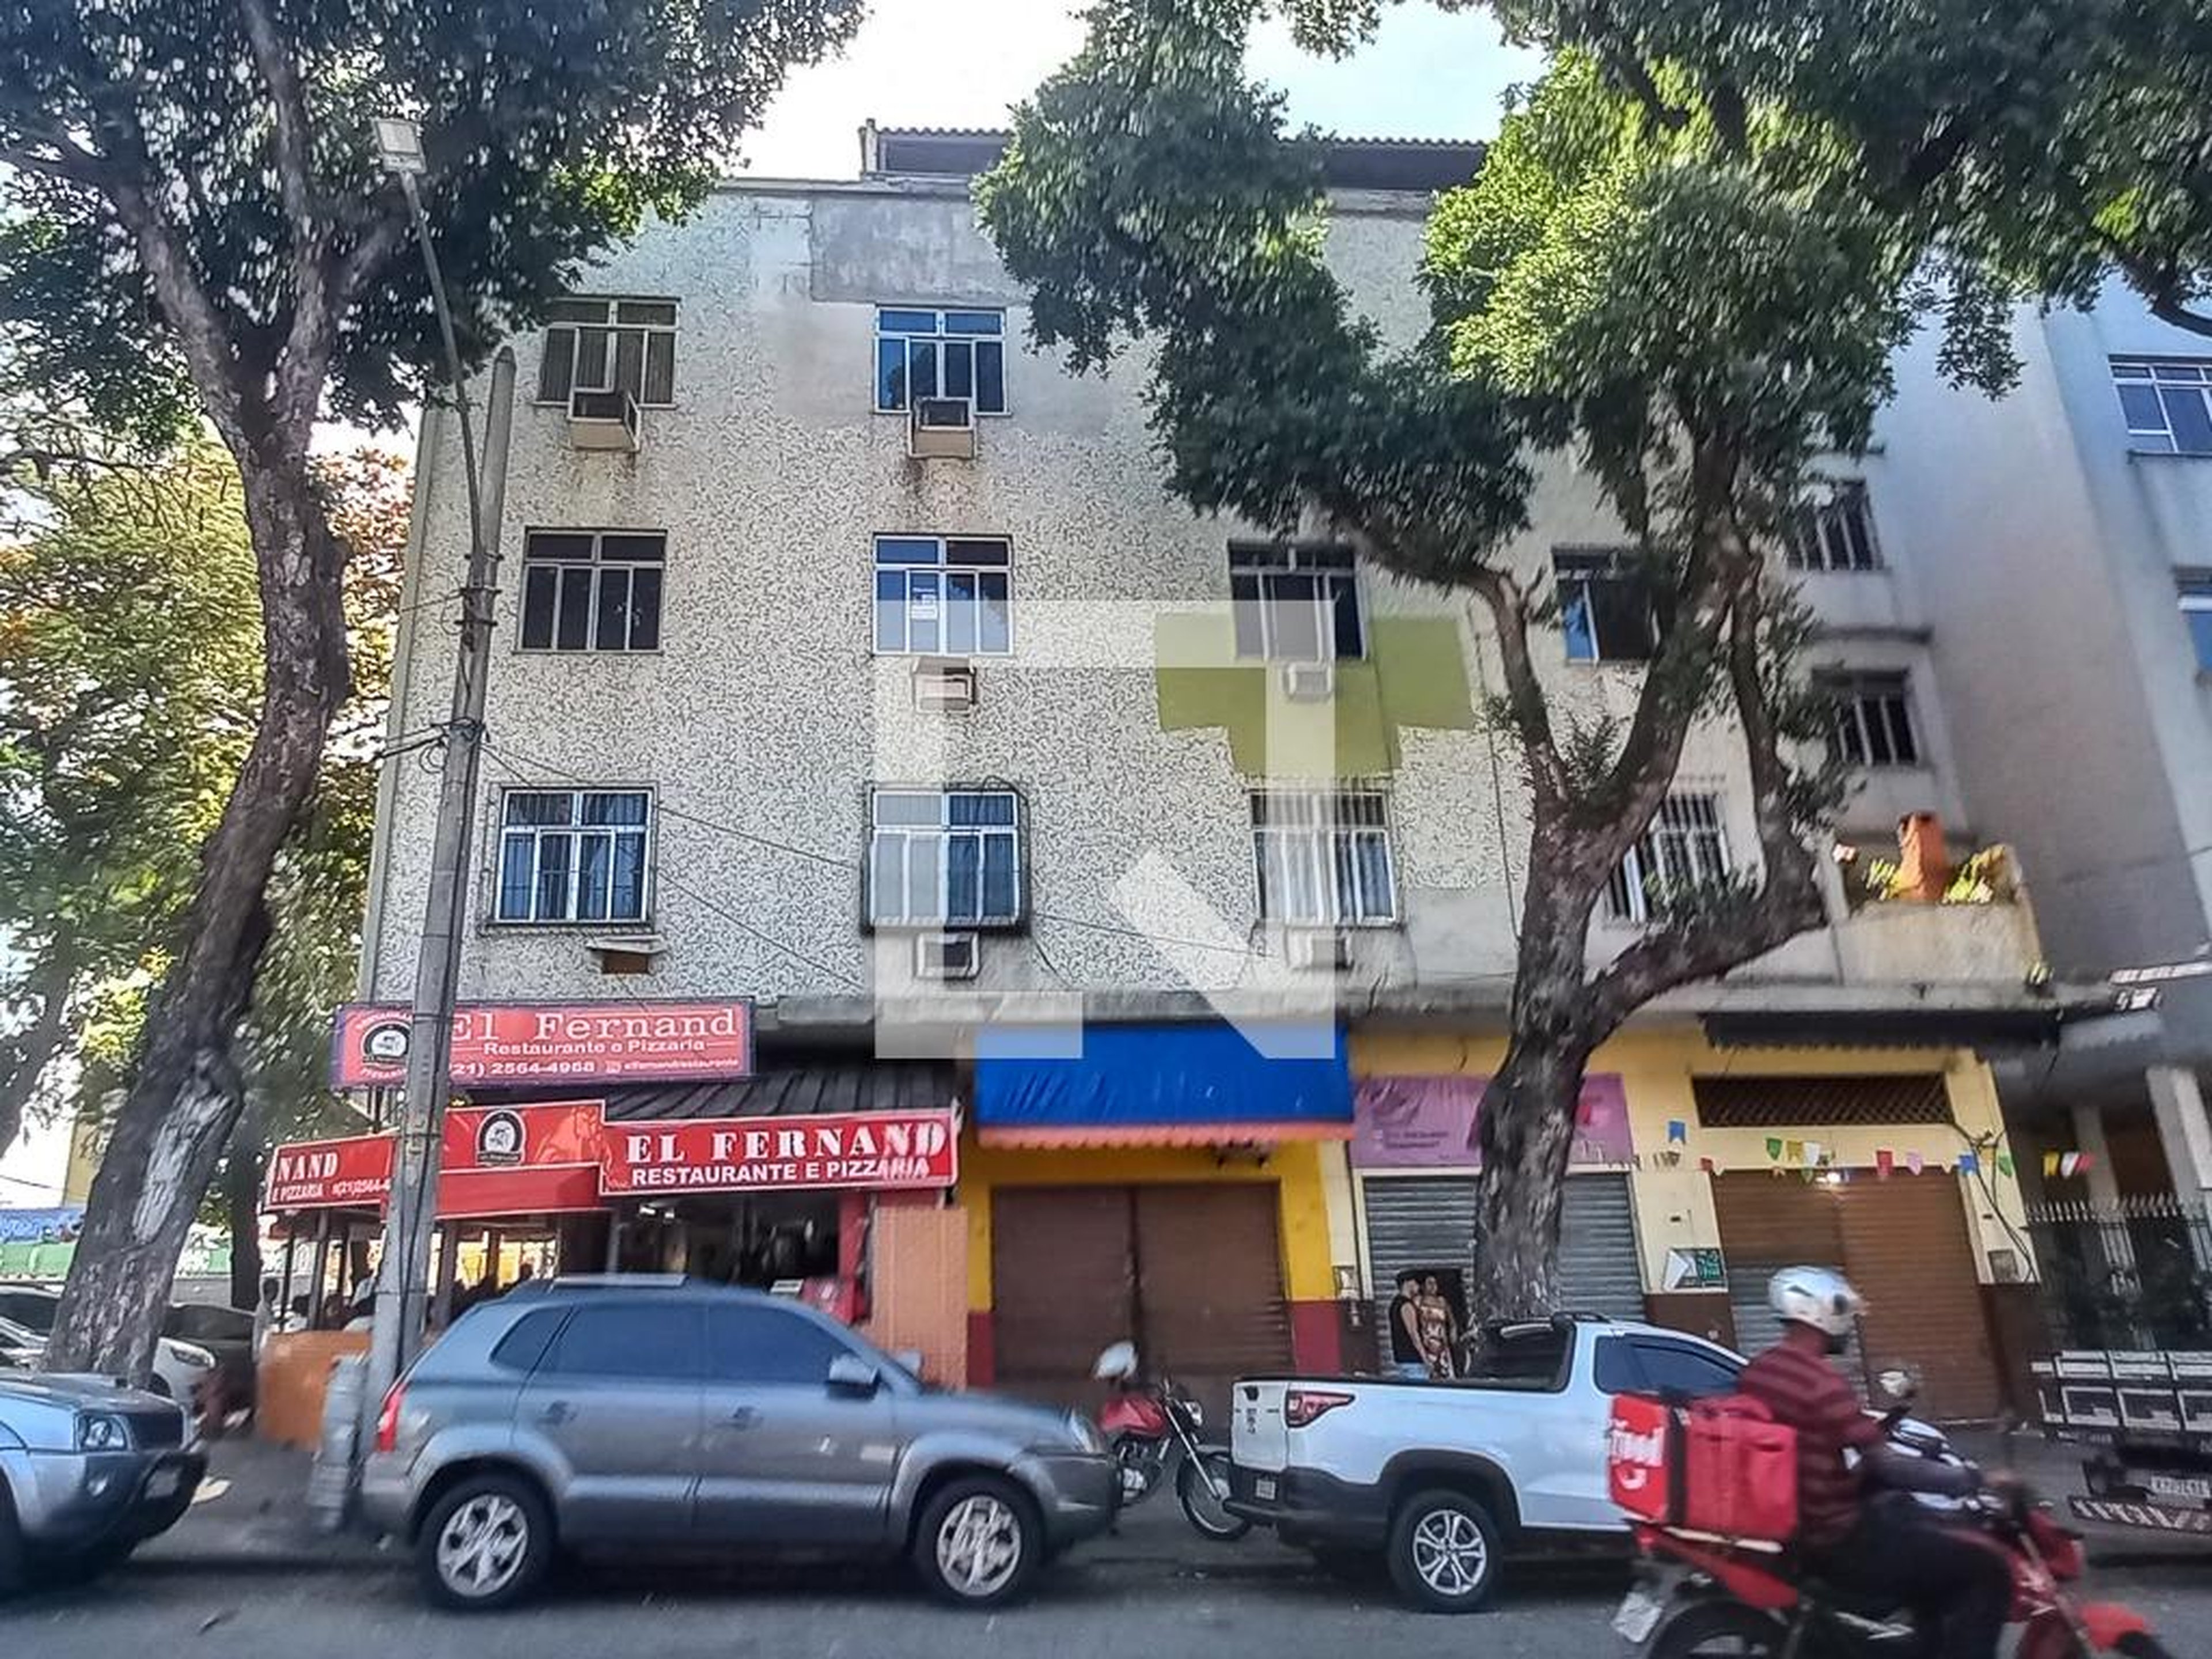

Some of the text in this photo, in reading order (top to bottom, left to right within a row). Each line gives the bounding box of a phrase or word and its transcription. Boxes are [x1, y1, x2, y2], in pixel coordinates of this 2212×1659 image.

[452, 1008, 738, 1040] El Fernand
[626, 1122, 947, 1163] EL FERNAND
[276, 1152, 338, 1181] NAND
[632, 1156, 930, 1185] RESTAURANTE E PIZZARIA
